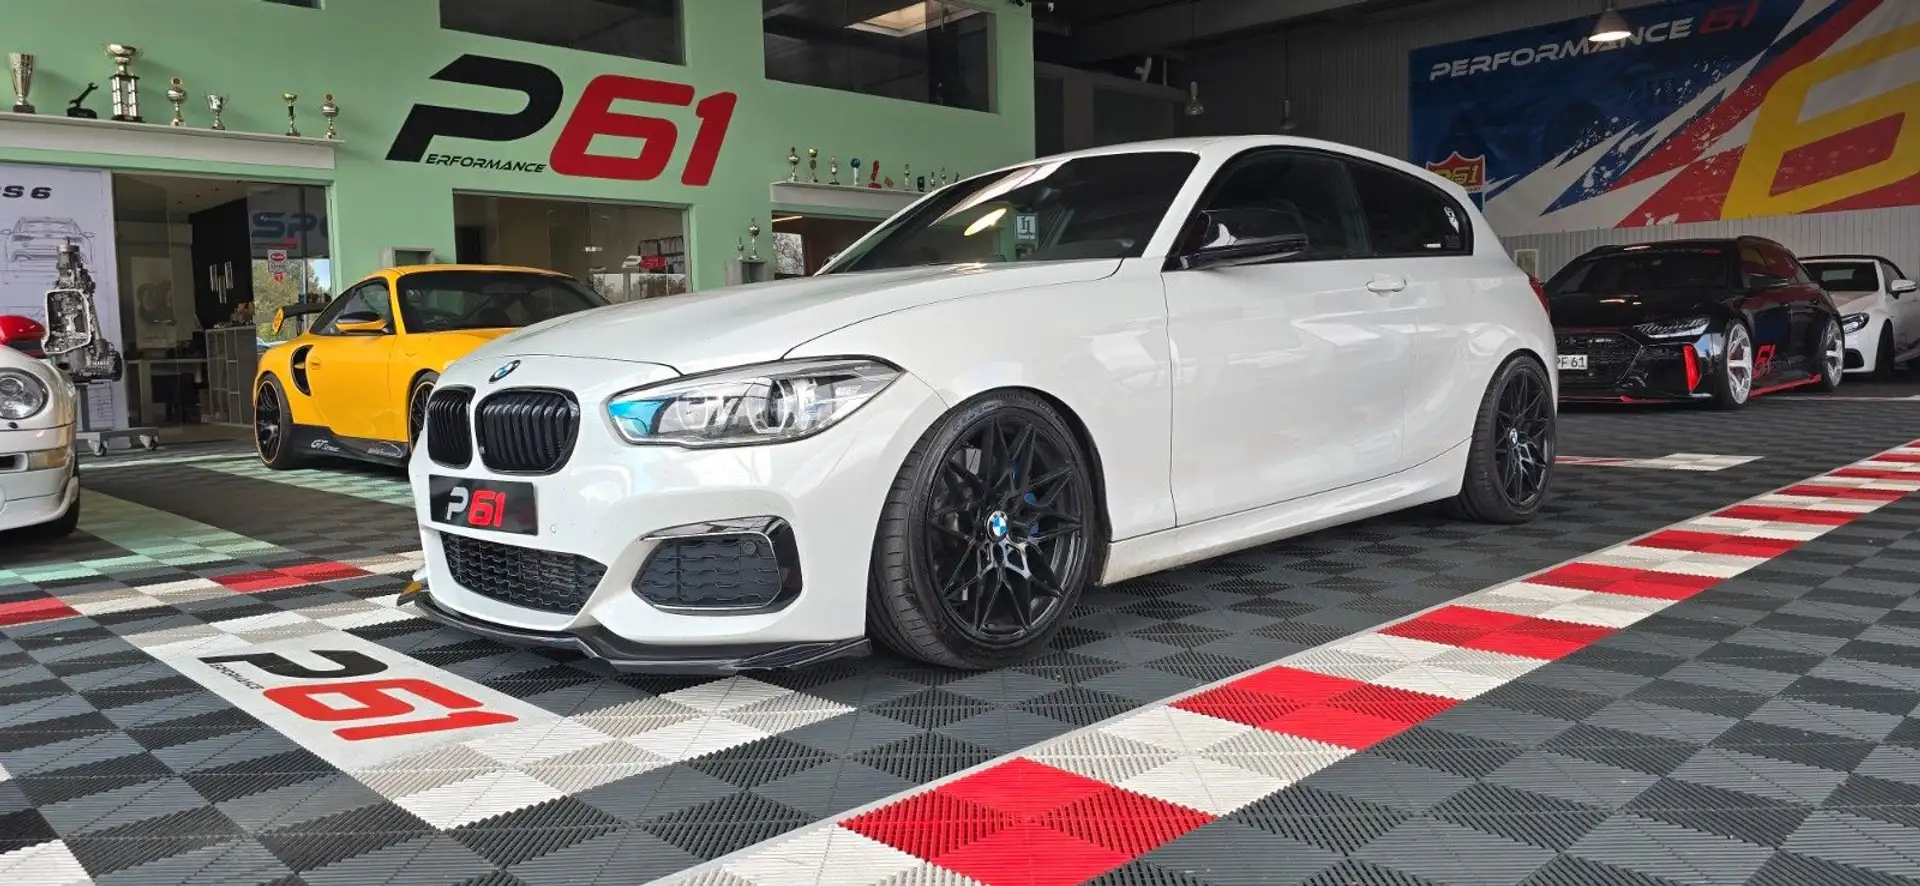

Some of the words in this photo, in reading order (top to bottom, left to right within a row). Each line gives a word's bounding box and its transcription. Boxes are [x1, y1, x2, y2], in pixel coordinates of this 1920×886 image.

[1698, 0, 1760, 34] 61
[385, 53, 738, 187] P61
[425, 153, 546, 173] ERFORMANCE
[0, 185, 25, 198] S
[30, 187, 52, 199] 6
[252, 211, 328, 239] SP
[1571, 356, 1585, 367] 61
[197, 649, 519, 741] P61
